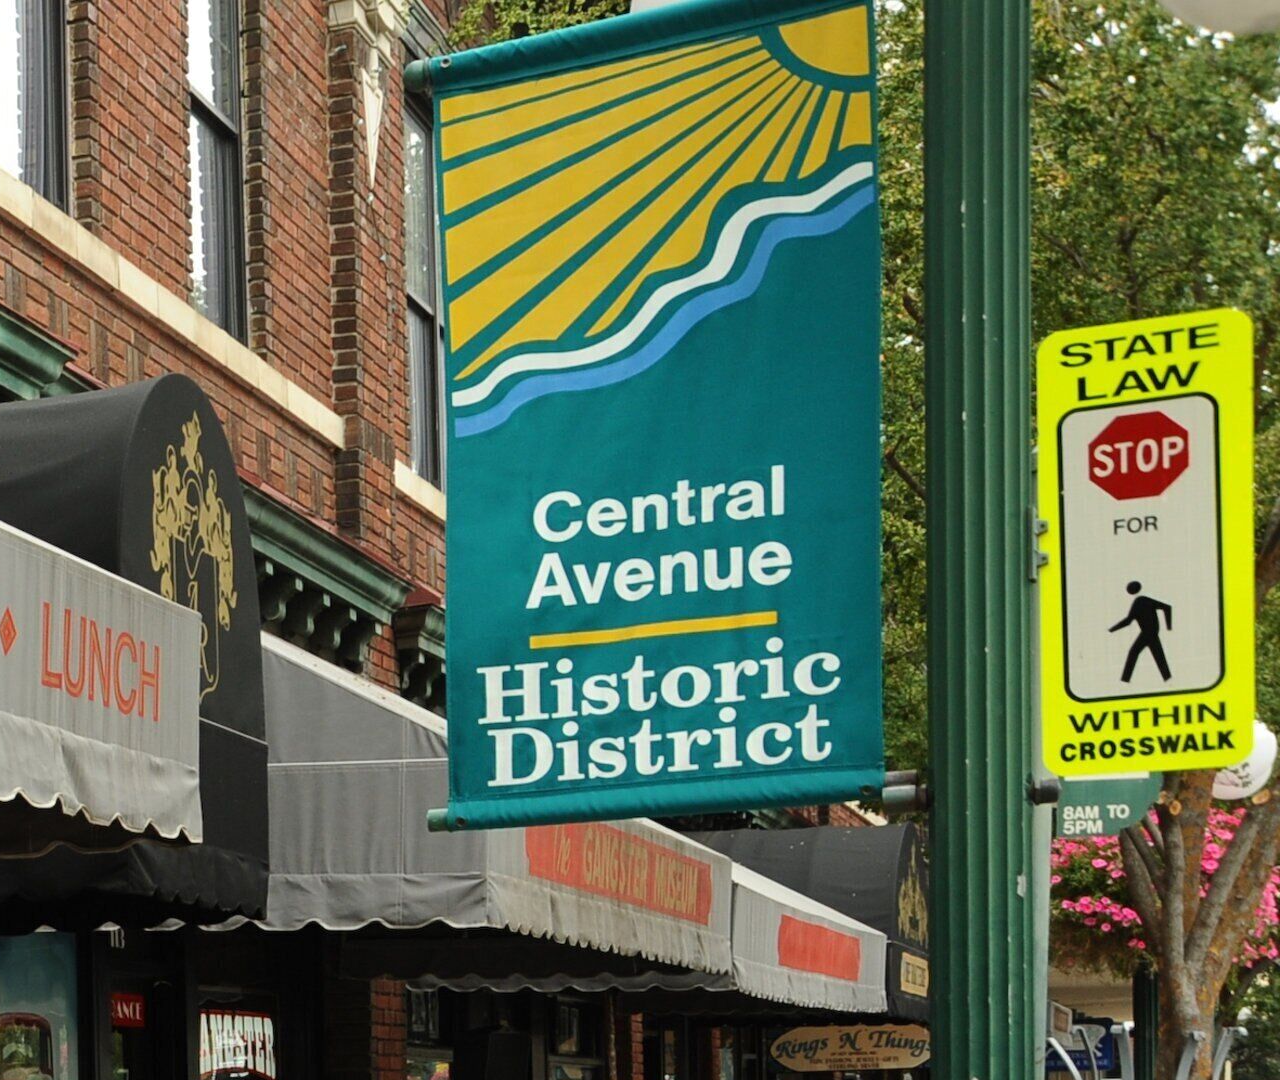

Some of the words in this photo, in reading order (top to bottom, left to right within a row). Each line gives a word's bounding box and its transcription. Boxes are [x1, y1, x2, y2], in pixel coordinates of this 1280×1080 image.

[1059, 323, 1220, 368] STATE
[1077, 361, 1201, 402] LAW
[1092, 435, 1186, 479] STOP
[532, 464, 786, 543] Central
[1113, 515, 1159, 535] FOR
[526, 541, 792, 610] Avenue
[41, 602, 162, 723] LUNCH
[477, 636, 842, 725] Historic
[1069, 701, 1227, 734] WITHIN
[487, 704, 833, 788] District
[1060, 730, 1236, 763] CROSSWALK
[1063, 804, 1100, 820] 8AM
[1107, 804, 1130, 819] TO
[1063, 819, 1103, 835] 5PM
[583, 828, 649, 901] GANGSTER
[654, 852, 700, 916] MUSEUM
[776, 1038, 829, 1060] Rings
